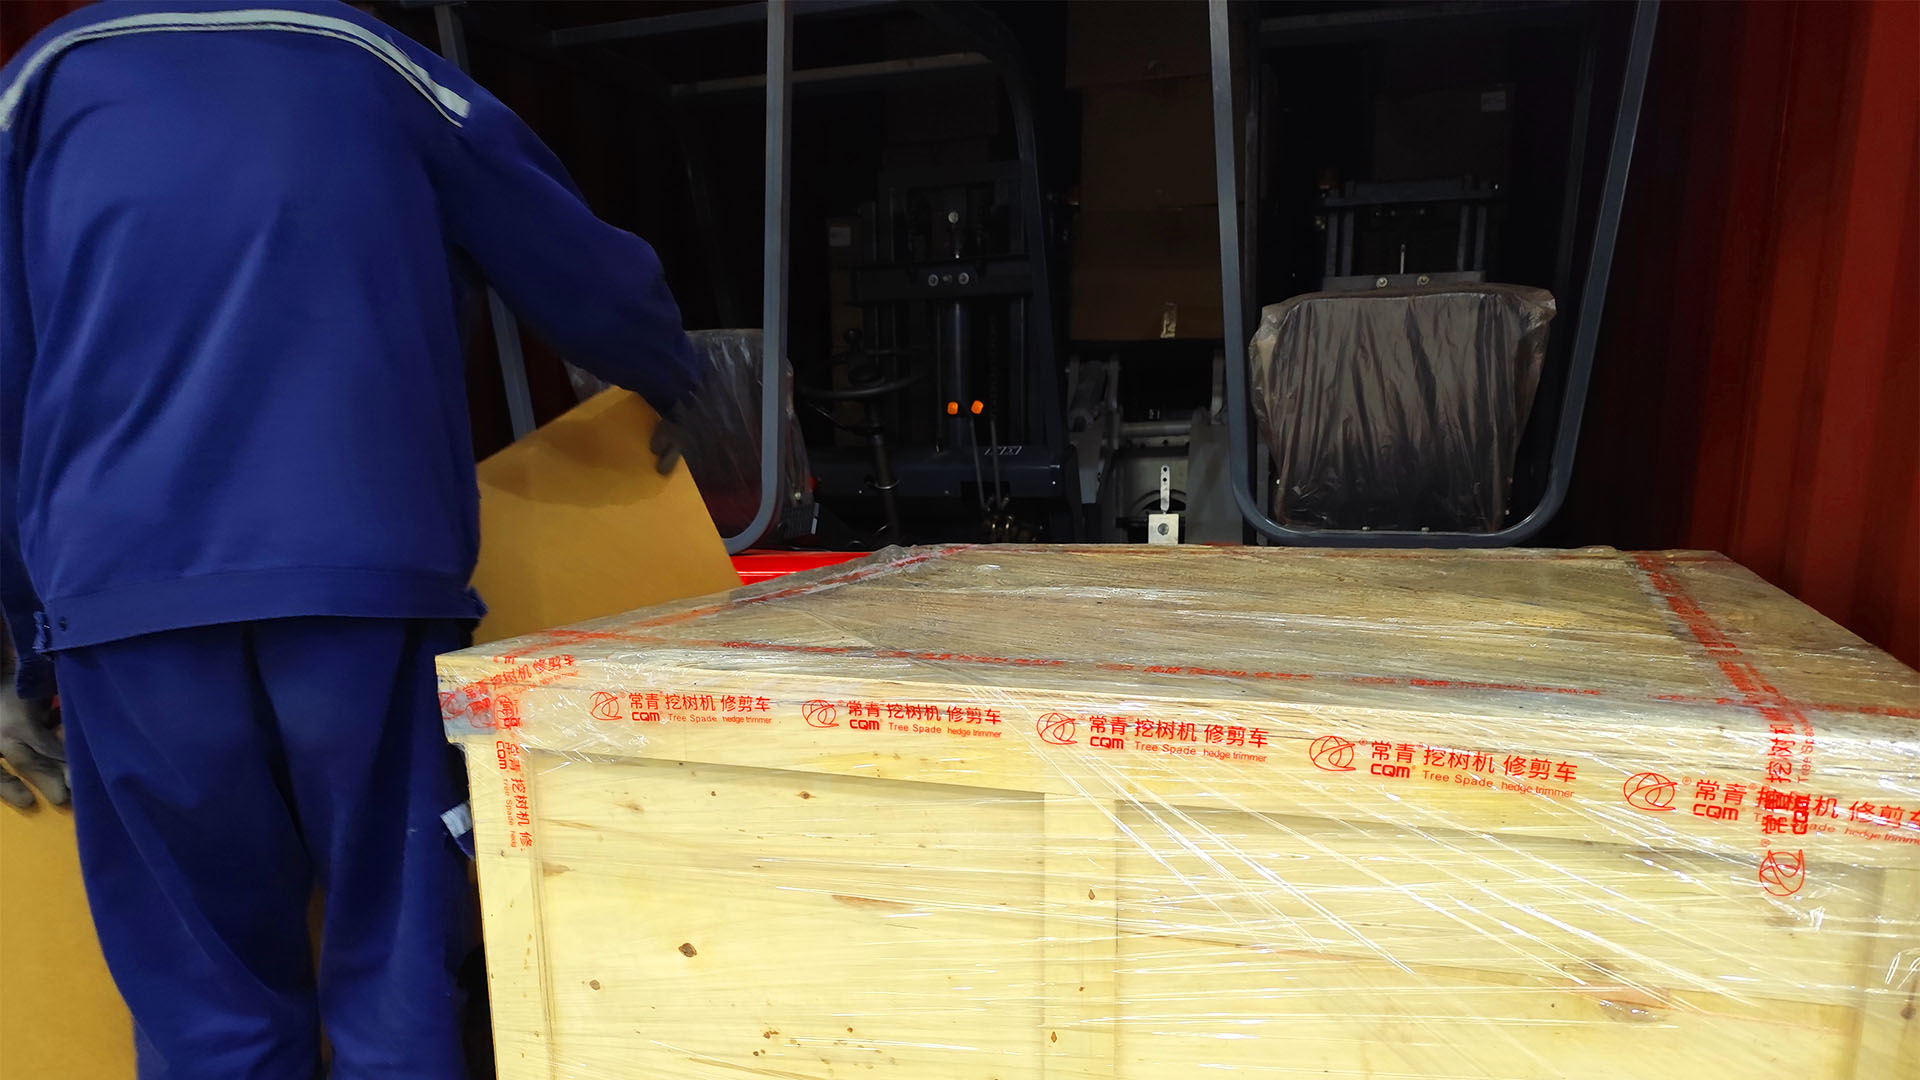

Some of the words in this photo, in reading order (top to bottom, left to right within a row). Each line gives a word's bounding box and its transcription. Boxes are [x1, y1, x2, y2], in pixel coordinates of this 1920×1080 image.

[629, 693, 658, 710] 常青
[665, 693, 716, 711] 挖树机
[720, 695, 771, 712] 修剪车
[846, 701, 880, 718] 常青
[887, 703, 941, 722] 挖树机
[946, 706, 1001, 725] 修剪车
[669, 713, 687, 722] Tree
[690, 714, 717, 724] Spade
[723, 716, 744, 724] hedge
[889, 722, 909, 732] Tree
[912, 723, 942, 734] Spade
[947, 727, 971, 737] hedge
[1089, 715, 1128, 736] 常青
[1134, 718, 1197, 742] 挖树机
[1203, 724, 1269, 748] 修剪车
[1135, 741, 1158, 752] Tree
[1162, 743, 1197, 756] Spade
[1203, 749, 1231, 760] hedge
[1371, 740, 1416, 764] 常青
[1423, 745, 1495, 774] 挖树机
[1503, 754, 1578, 783] 修剪车
[1422, 770, 1449, 783] Tree
[1454, 774, 1494, 789] Spade
[1501, 782, 1533, 795] hedge
[1695, 778, 1747, 806] 常青
[511, 778, 530, 826] 挖树机
